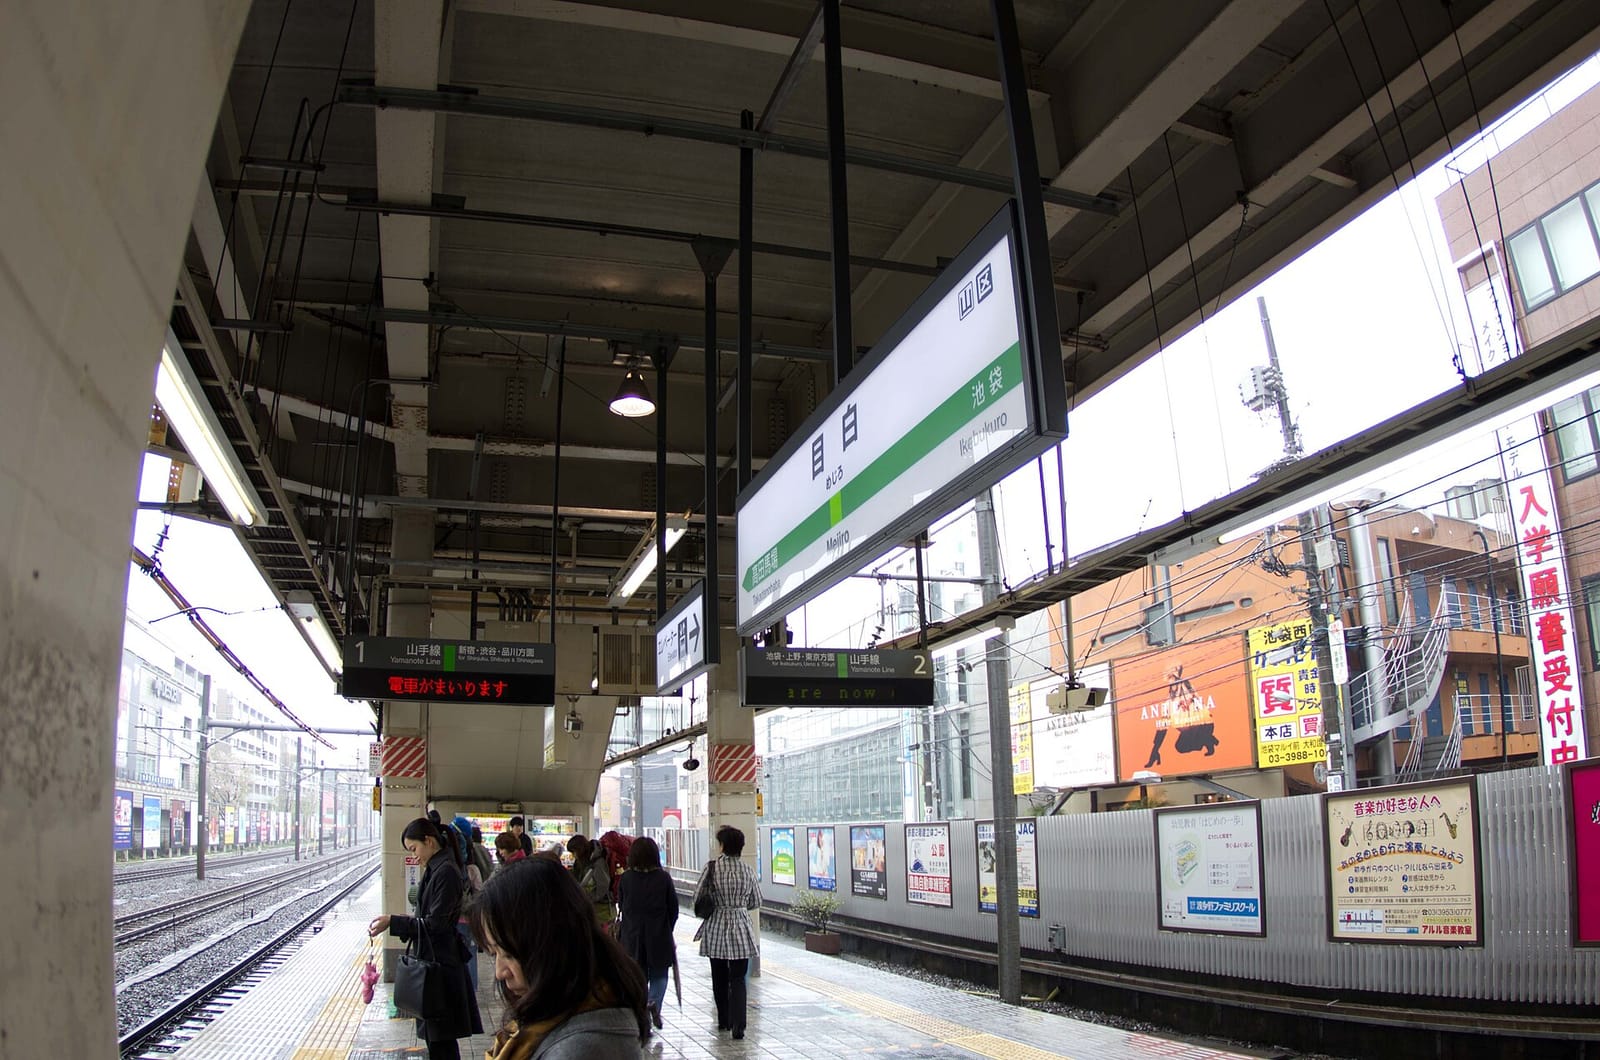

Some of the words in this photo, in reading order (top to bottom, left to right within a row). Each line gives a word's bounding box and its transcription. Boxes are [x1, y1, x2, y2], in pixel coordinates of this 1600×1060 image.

[971, 365, 1003, 409] 池袋
[812, 403, 858, 481] 目白
[959, 412, 1008, 457] Ikebukuro
[826, 465, 844, 490] めじろ
[826, 529, 850, 552] Mejiro
[1519, 485, 1579, 765] 入学願書受付中
[354, 641, 365, 664] 1
[407, 643, 441, 657] 山手線
[458, 645, 535, 658] 新宿・渋谷・品川方面
[766, 651, 835, 662] 池袋・上野・東京方面
[850, 654, 880, 666] 山手線
[390, 656, 424, 666] Yamanote
[426, 658, 441, 666] Line
[851, 666, 880, 674] Yamanote
[914, 654, 926, 675] 2
[388, 676, 508, 697] 電車がまいります
[786, 687, 822, 699] are
[839, 687, 877, 699] now
[1261, 677, 1294, 715] 質
[1265, 724, 1292, 740] 本店
[1354, 795, 1441, 816] 音楽が好きな人へ
[1341, 841, 1464, 870] あの名曲も自分で演奏してみよう
[1422, 925, 1472, 935] アルル音楽教室
